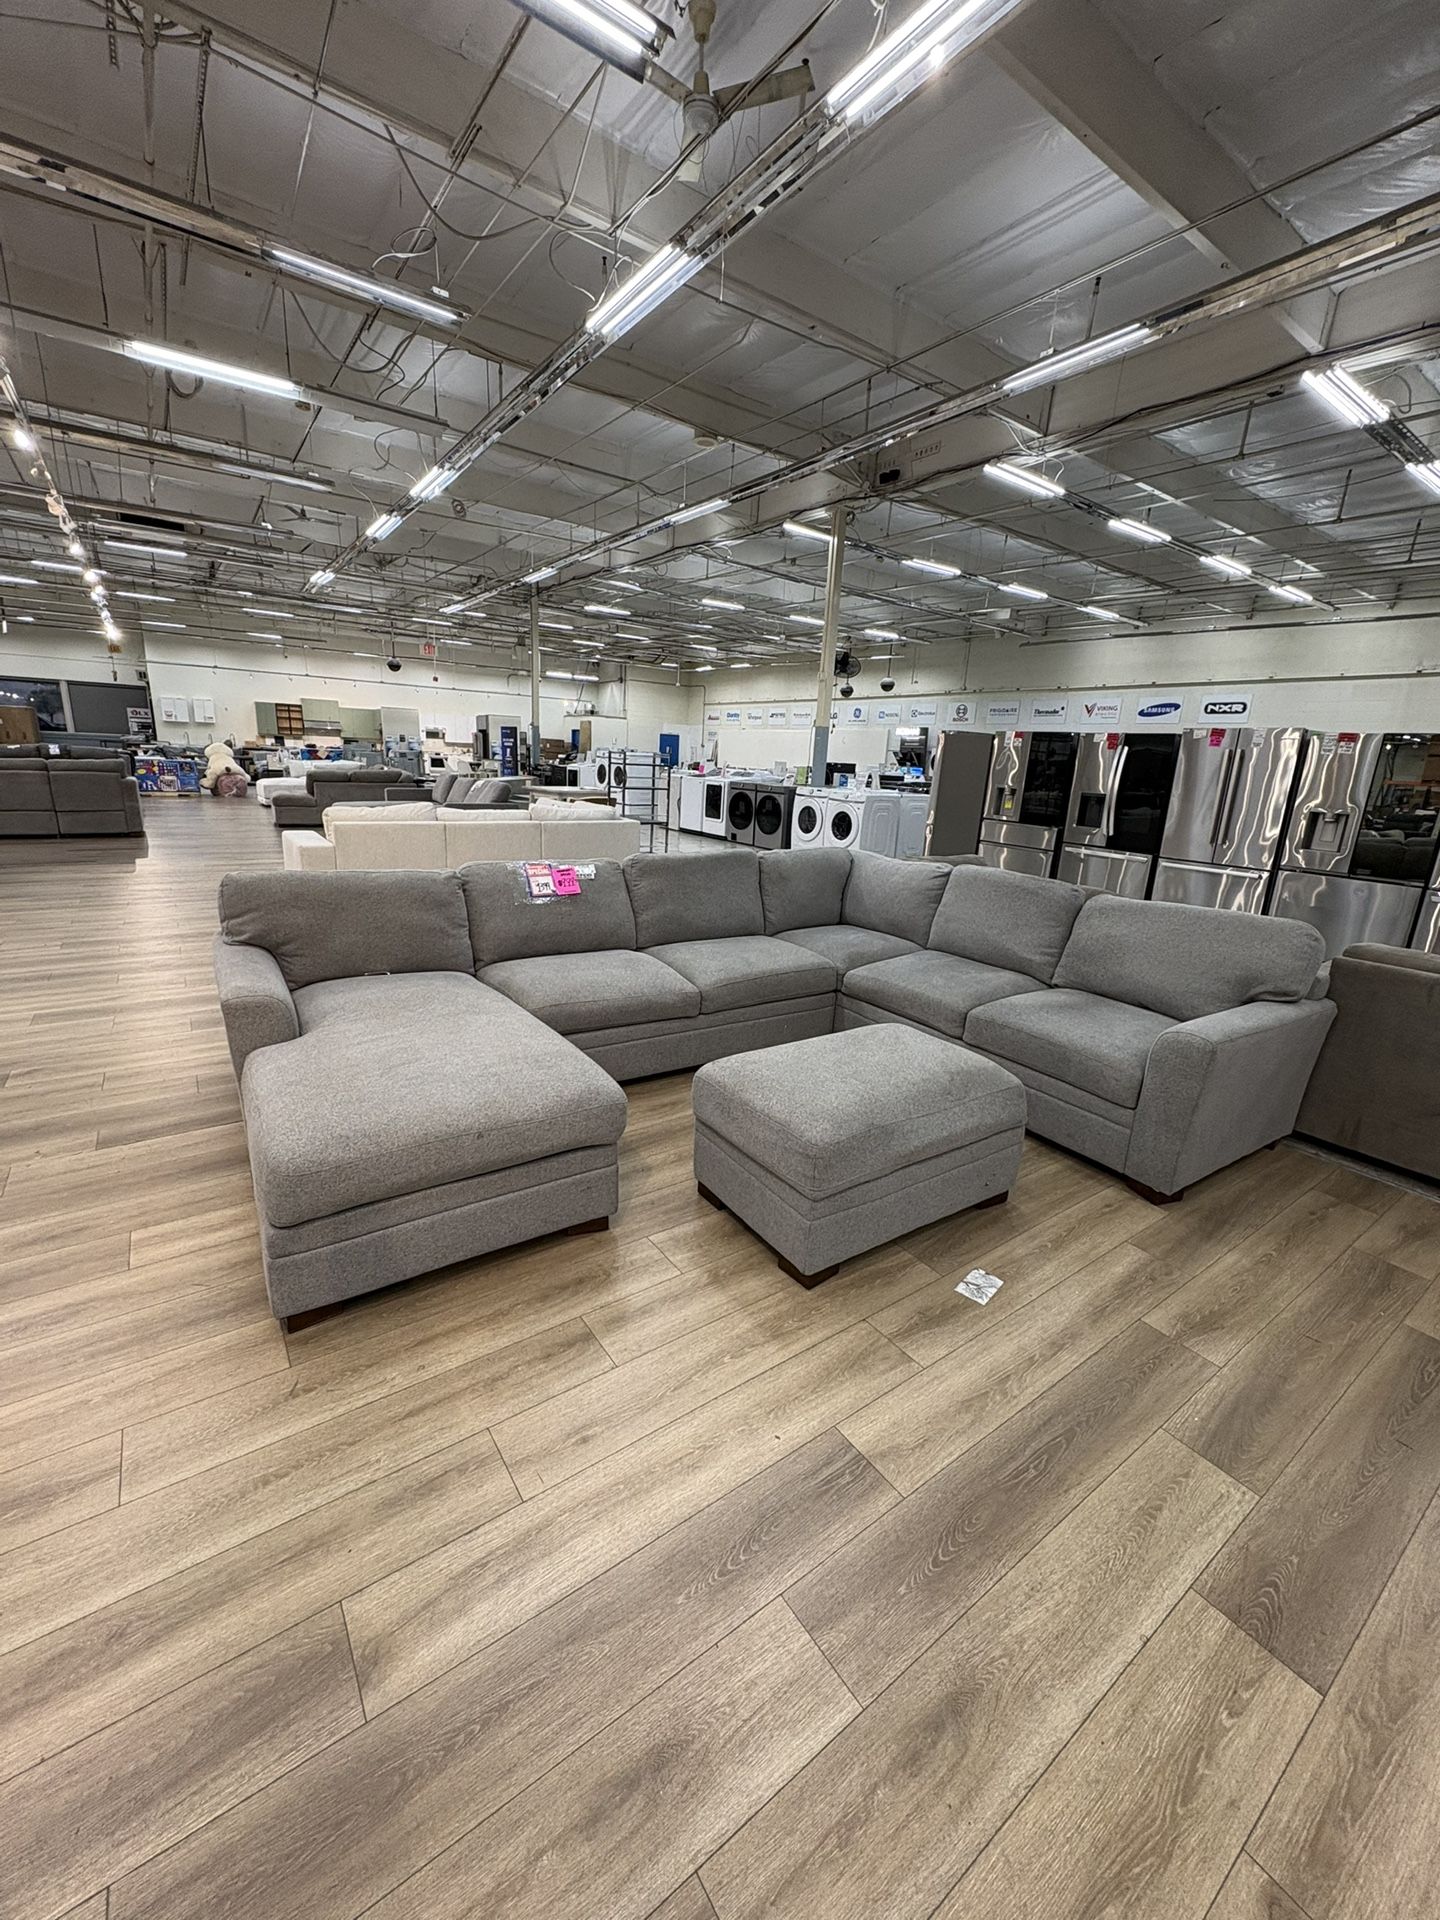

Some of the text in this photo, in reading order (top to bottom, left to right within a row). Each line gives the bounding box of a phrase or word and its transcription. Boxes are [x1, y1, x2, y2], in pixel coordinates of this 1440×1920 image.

[1096, 704, 1119, 713] VIKING
[1143, 706, 1176, 714] SAMSUNG
[1206, 703, 1244, 713] NXR
[830, 712, 838, 720] LG
